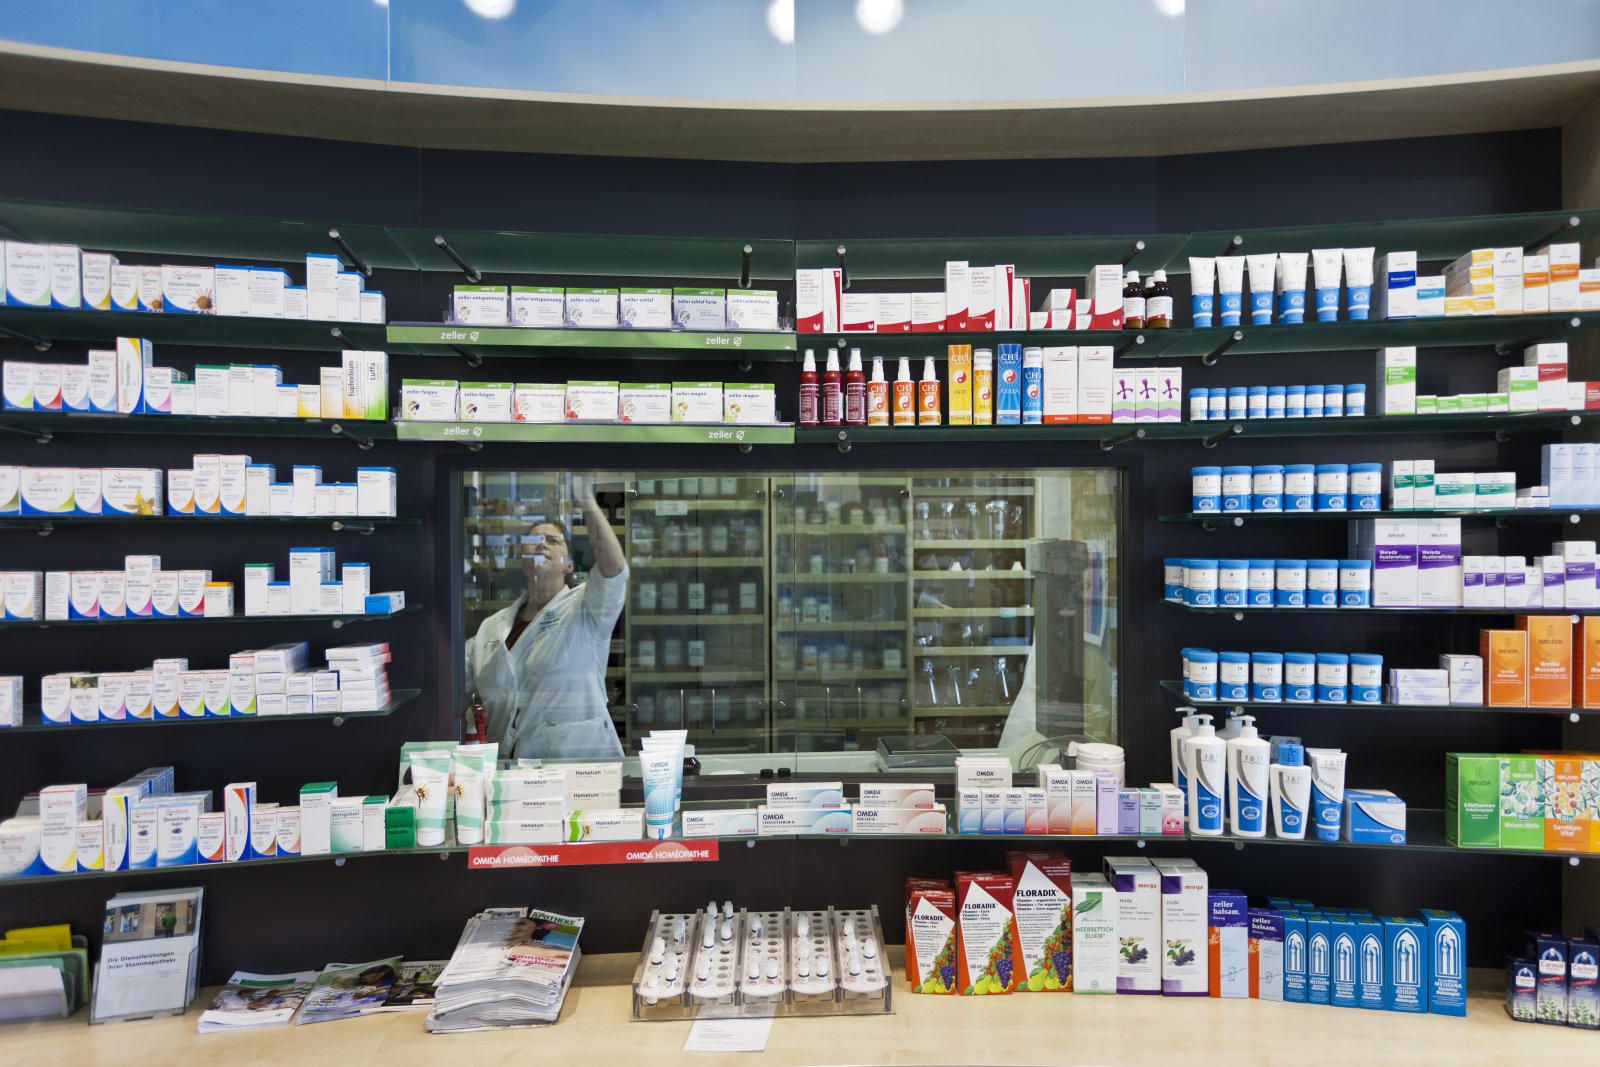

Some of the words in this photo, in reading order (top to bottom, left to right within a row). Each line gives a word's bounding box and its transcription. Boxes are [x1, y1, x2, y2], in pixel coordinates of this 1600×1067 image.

[440, 331, 467, 340] zeller
[705, 336, 730, 345] zeller
[444, 426, 470, 436] zeller
[708, 430, 732, 439] zeller
[331, 810, 360, 818] Vertigoheel
[473, 856, 502, 865] OMIDA
[503, 854, 560, 864] HOMÉOPATHIE
[626, 852, 654, 860] OMIDA
[655, 850, 709, 859] HOMÉOPATHIE
[1016, 889, 1057, 897] FLORADIX
[1212, 900, 1234, 908] zeller
[1212, 907, 1241, 915] balsam.
[532, 912, 576, 926] APOTHEKE
[1252, 917, 1271, 925] zeller
[1252, 923, 1278, 932] balsam.
[120, 951, 175, 962] Dienstleistungen
[108, 962, 124, 970] Ihrer
[125, 958, 176, 968] Stammapotheke
[1541, 960, 1564, 969] Carmol
[1434, 981, 1462, 989] MELISANA
[1395, 988, 1418, 996] MELISANA
